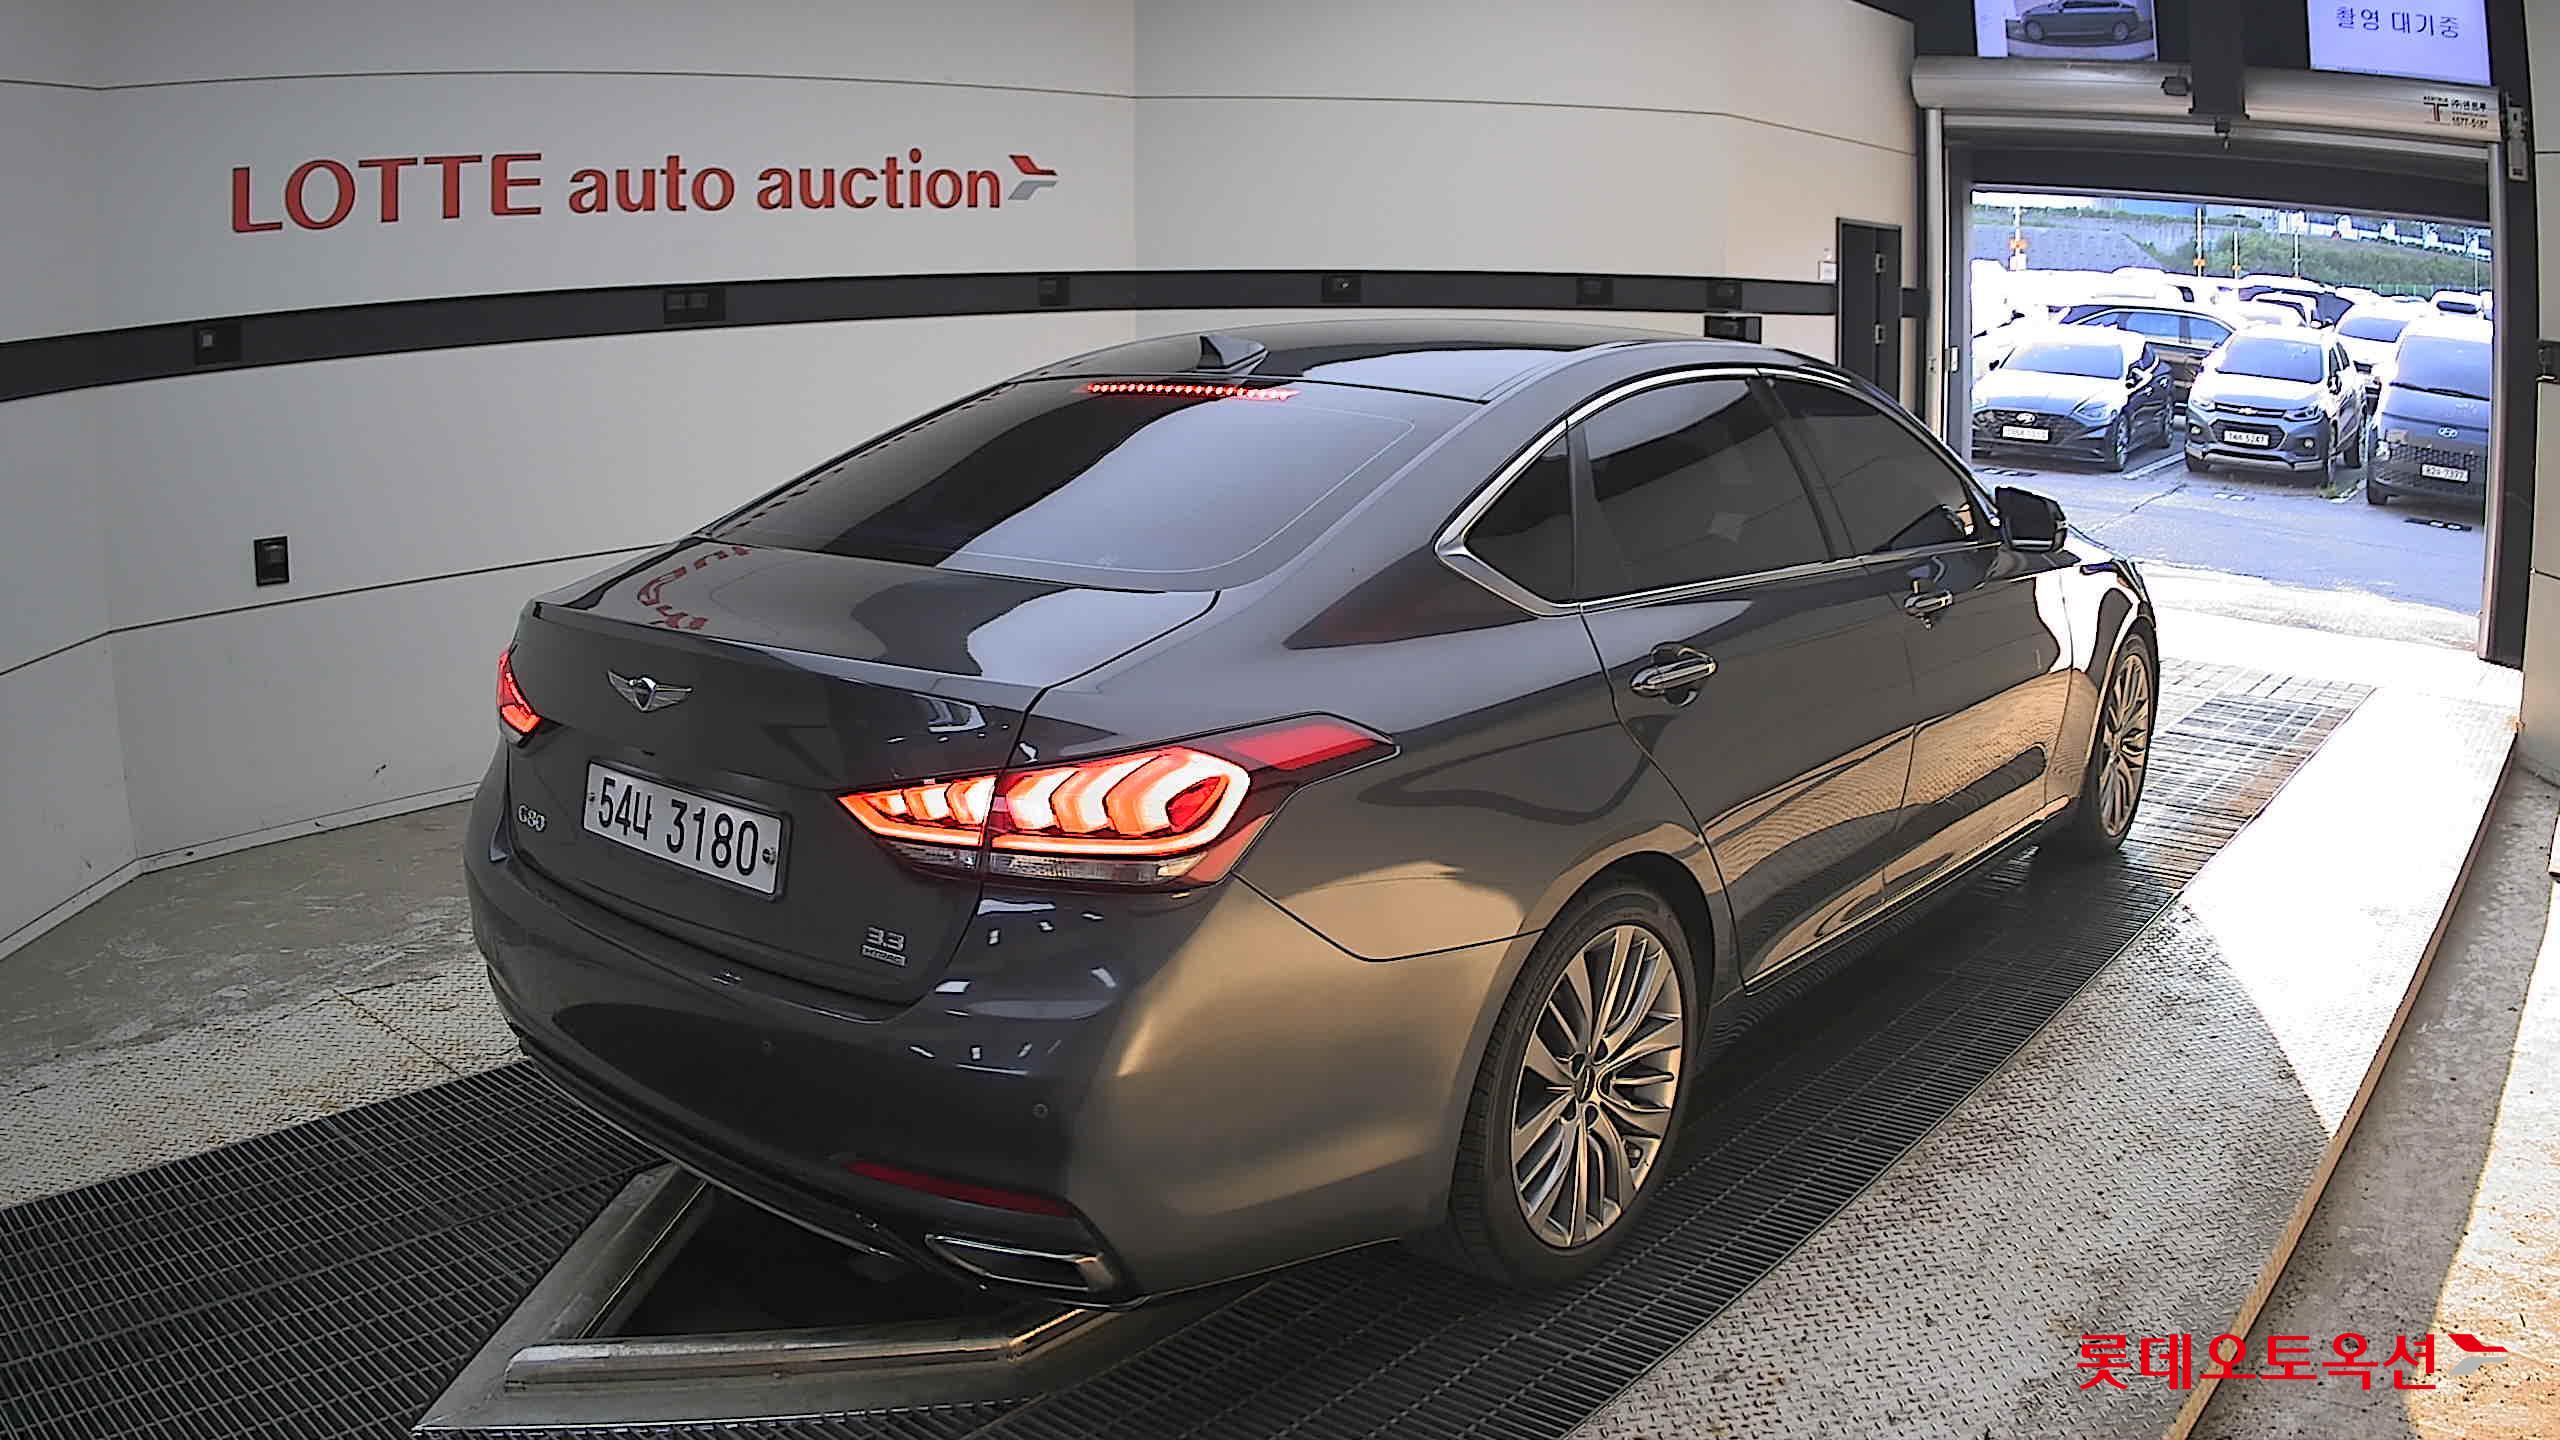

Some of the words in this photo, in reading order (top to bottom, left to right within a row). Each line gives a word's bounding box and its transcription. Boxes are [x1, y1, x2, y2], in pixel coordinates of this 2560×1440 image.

[2336, 6, 2380, 31] 촬영
[2391, 11, 2459, 39] 대기중
[231, 153, 543, 234] LOTTE
[568, 155, 736, 214] auto
[757, 148, 1001, 211] auction
[518, 804, 546, 832] G80
[599, 776, 653, 841] 54나
[666, 798, 759, 877] 3180
[866, 927, 905, 952] 3.3
